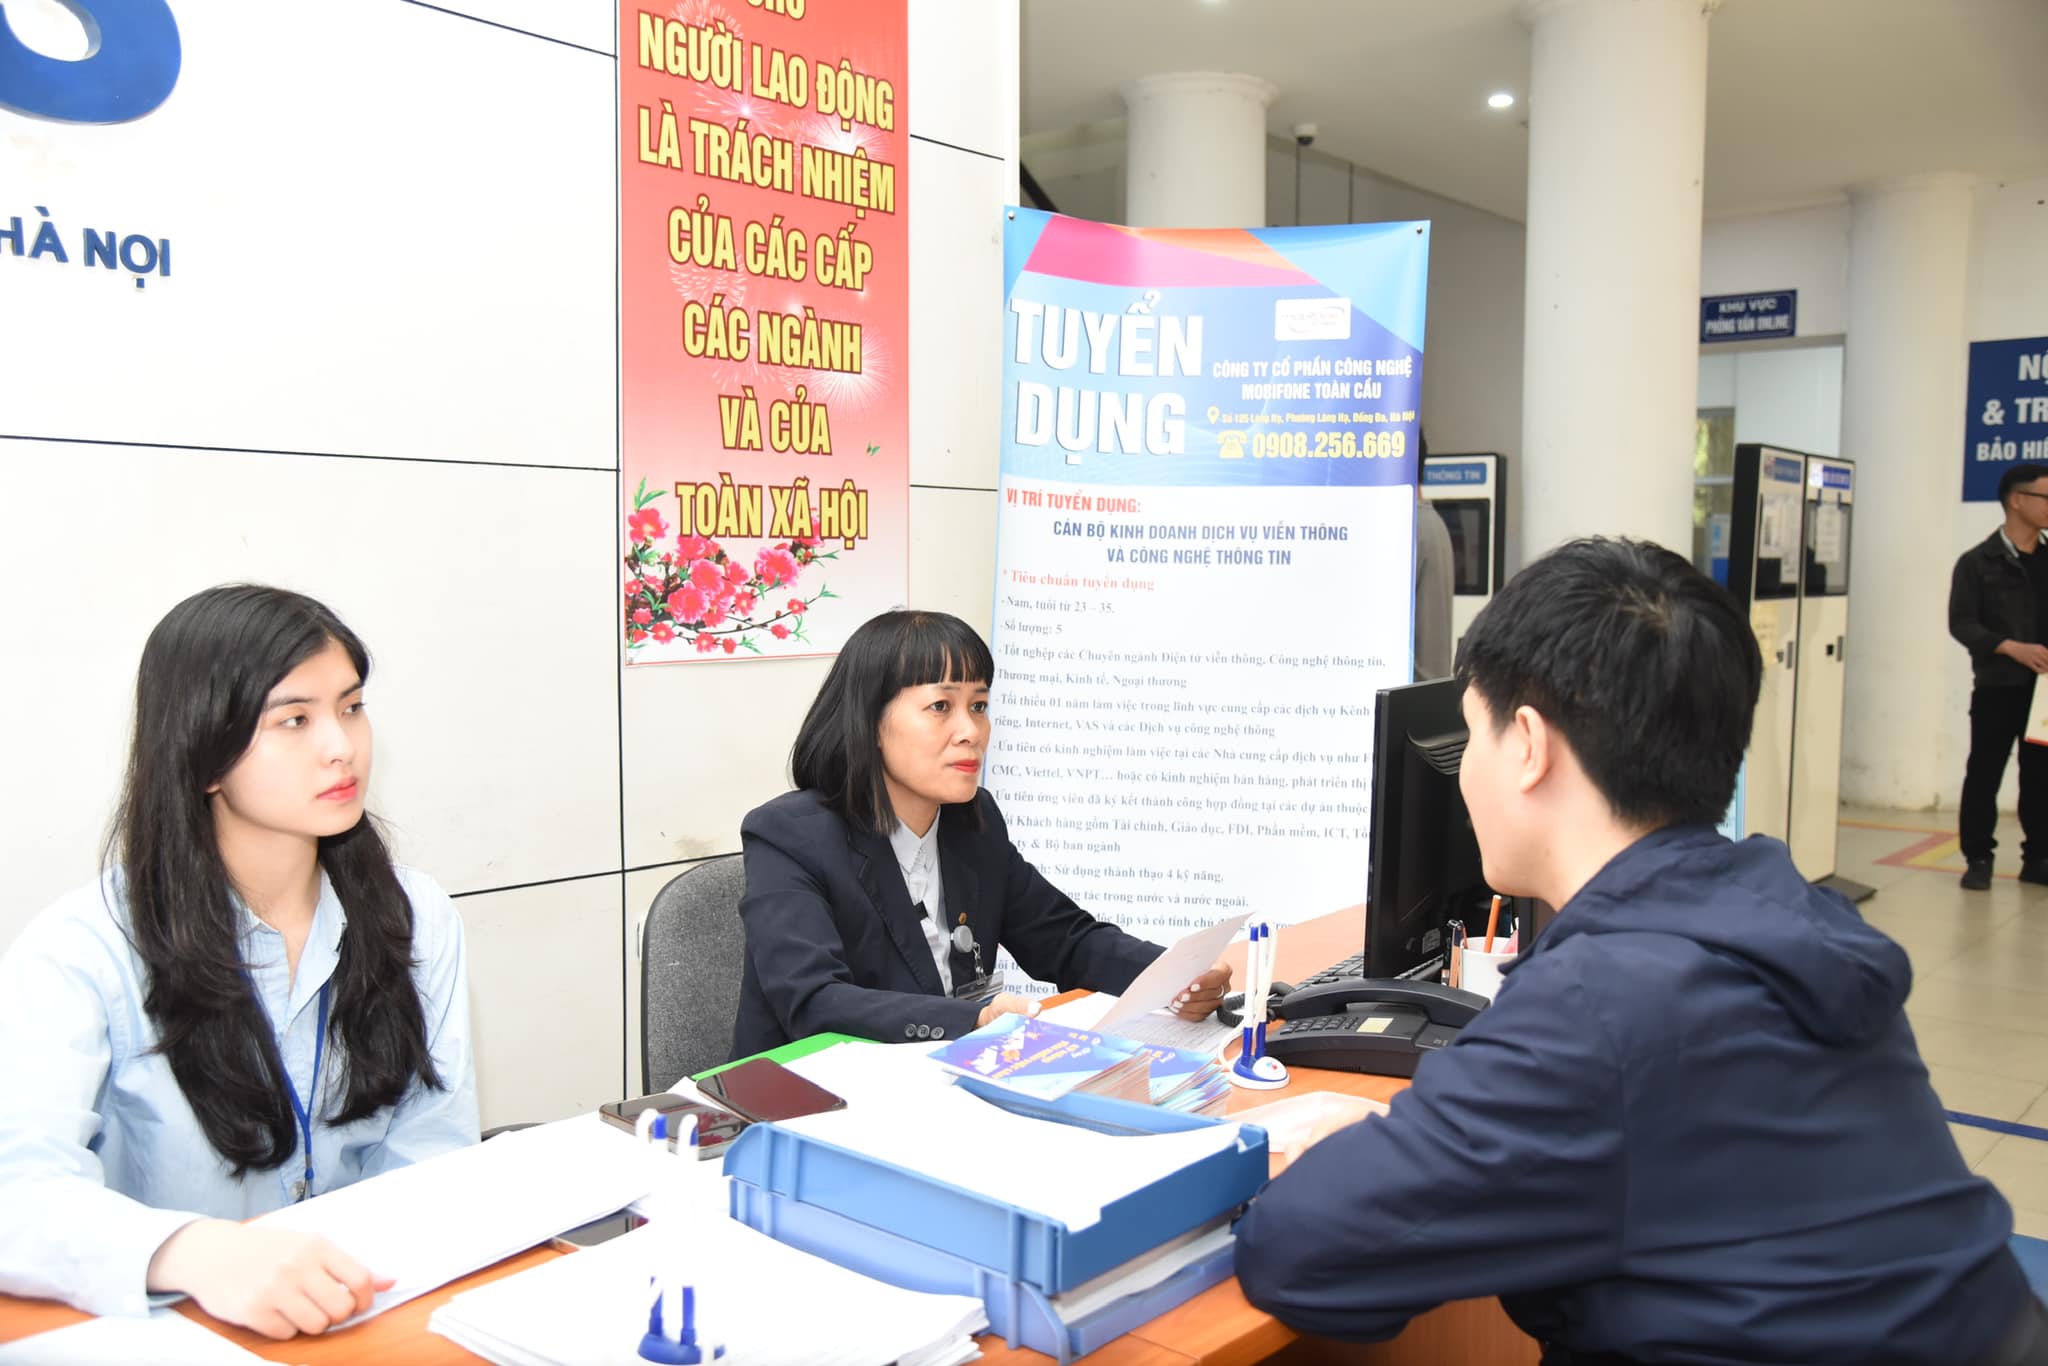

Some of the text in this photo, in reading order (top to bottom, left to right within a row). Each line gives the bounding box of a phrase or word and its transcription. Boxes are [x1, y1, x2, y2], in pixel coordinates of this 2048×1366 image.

[637, 9, 895, 133] NGƯỜI LAO ĐỘNG
[638, 98, 896, 220] LÀ TRÁCH NHIỆM
[668, 193, 873, 292] CỦA CÁC CẤP
[682, 293, 863, 375] CÁC NGÀNH
[1009, 289, 1203, 378] TUYỂN
[1213, 360, 1248, 378] CÔNG
[1253, 362, 1268, 377] TY
[1335, 357, 1372, 376] CÔNG
[1376, 356, 1412, 378] NGHỆ
[1242, 382, 1310, 400] MOBIFONE
[1315, 380, 1350, 400] TOÀN
[718, 383, 833, 456] VÀ CỦA
[1015, 380, 1186, 465] DỤNG
[1982, 398, 2005, 426] &
[1252, 430, 1406, 459] 0908.256.669
[1976, 435, 2017, 462] BẢO
[675, 472, 869, 550] TOÀN XÃ HỘI
[1006, 488, 1142, 516] VỊ TRÍ TUYỂN DỤNG:
[1054, 518, 1348, 544] CÁN BỘ KINH DOANH DỊCH VỤ VIỄN THÔNG
[1107, 546, 1292, 568] VÀ CÔNG NGHỆ THÔNG TIN
[1011, 569, 1155, 593] Tiêu chuẩn tuyển dụng
[1008, 596, 1115, 616] Nam, 23 35.
[1004, 617, 1063, 635] Số lượng: 5
[1269, 654, 1300, 666] Công
[1302, 656, 1328, 668] nghệ
[1332, 656, 1364, 668] thông
[998, 668, 1036, 684] Thương
[1066, 673, 1093, 684] Kinh
[1112, 675, 1144, 688] Ngoại
[1049, 697, 1061, 708] 01
[1116, 699, 1137, 712] việc
[1140, 702, 1170, 712] trong
[1220, 705, 1248, 715] cung
[1340, 705, 1370, 716] Kênh
[1075, 720, 1100, 730] VAS
[1140, 721, 1164, 733] Dịch
[1184, 723, 1210, 736] công
[1214, 724, 1240, 736] nghệ
[1244, 725, 1276, 737] thông
[1054, 744, 1080, 755] kinh
[1082, 745, 1123, 757] nghiệm
[1214, 748, 1236, 759] Nhà
[1239, 752, 1266, 762] cung
[1161, 772, 1186, 783] kinh
[1189, 773, 1230, 786] nghiệm
[1176, 800, 1202, 809] công
[1016, 816, 1052, 827] Khách
[1031, 838, 1120, 852] & Bộ ban ngành
[1073, 866, 1173, 880] dụng thành thạo 4
[1104, 893, 1134, 904] trong
[1026, 981, 1049, 995] theo
